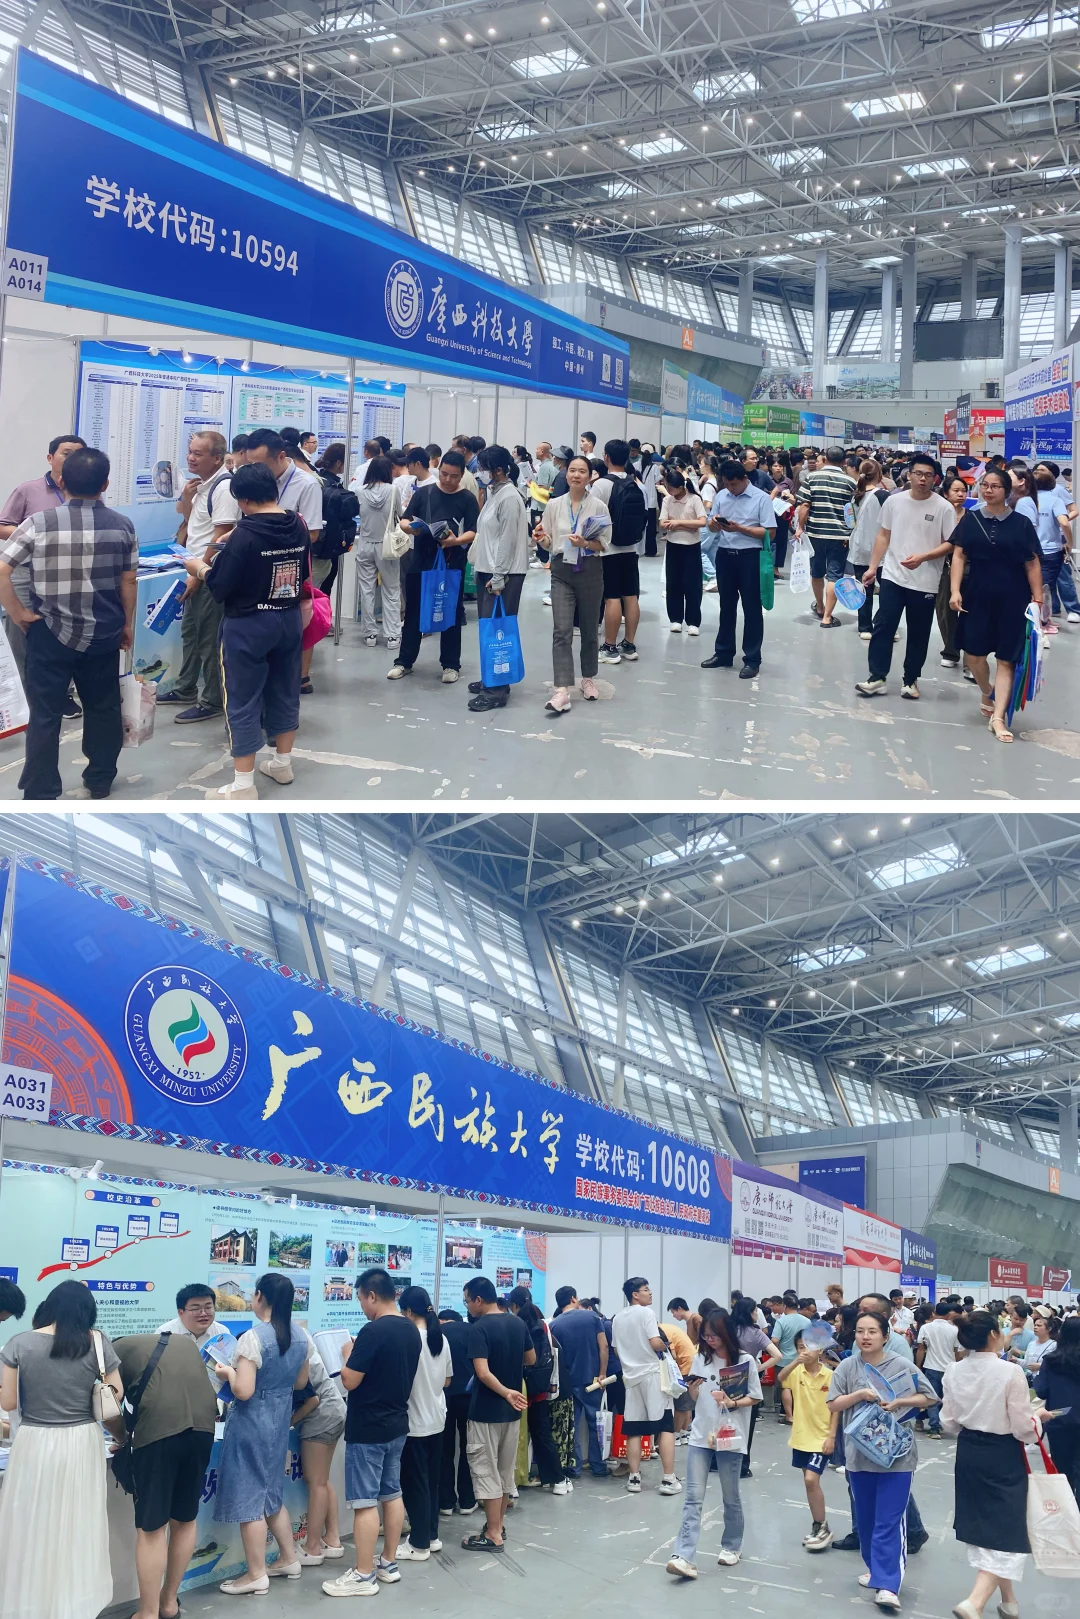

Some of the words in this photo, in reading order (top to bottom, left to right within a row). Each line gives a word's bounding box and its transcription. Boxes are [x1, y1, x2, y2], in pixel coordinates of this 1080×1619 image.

[86, 175, 299, 276] 学校代码:10594
[8, 257, 43, 276] A011
[7, 275, 42, 293] A014
[426, 333, 449, 347] Guangxi
[450, 339, 476, 356] University
[477, 347, 484, 355] of
[484, 348, 501, 360] Science
[502, 354, 510, 362] and
[511, 356, 532, 369] Technology
[132, 1012, 158, 1076] GUANGXI
[159, 1074, 197, 1097] MINZU
[200, 1044, 242, 1097] UNIVERSITY
[4, 1073, 47, 1094] A031
[1, 1093, 46, 1113] A033
[106, 1193, 142, 1205] 校史沿革
[97, 1282, 138, 1291] 特色与优势
[809, 1453, 822, 1469] 11
